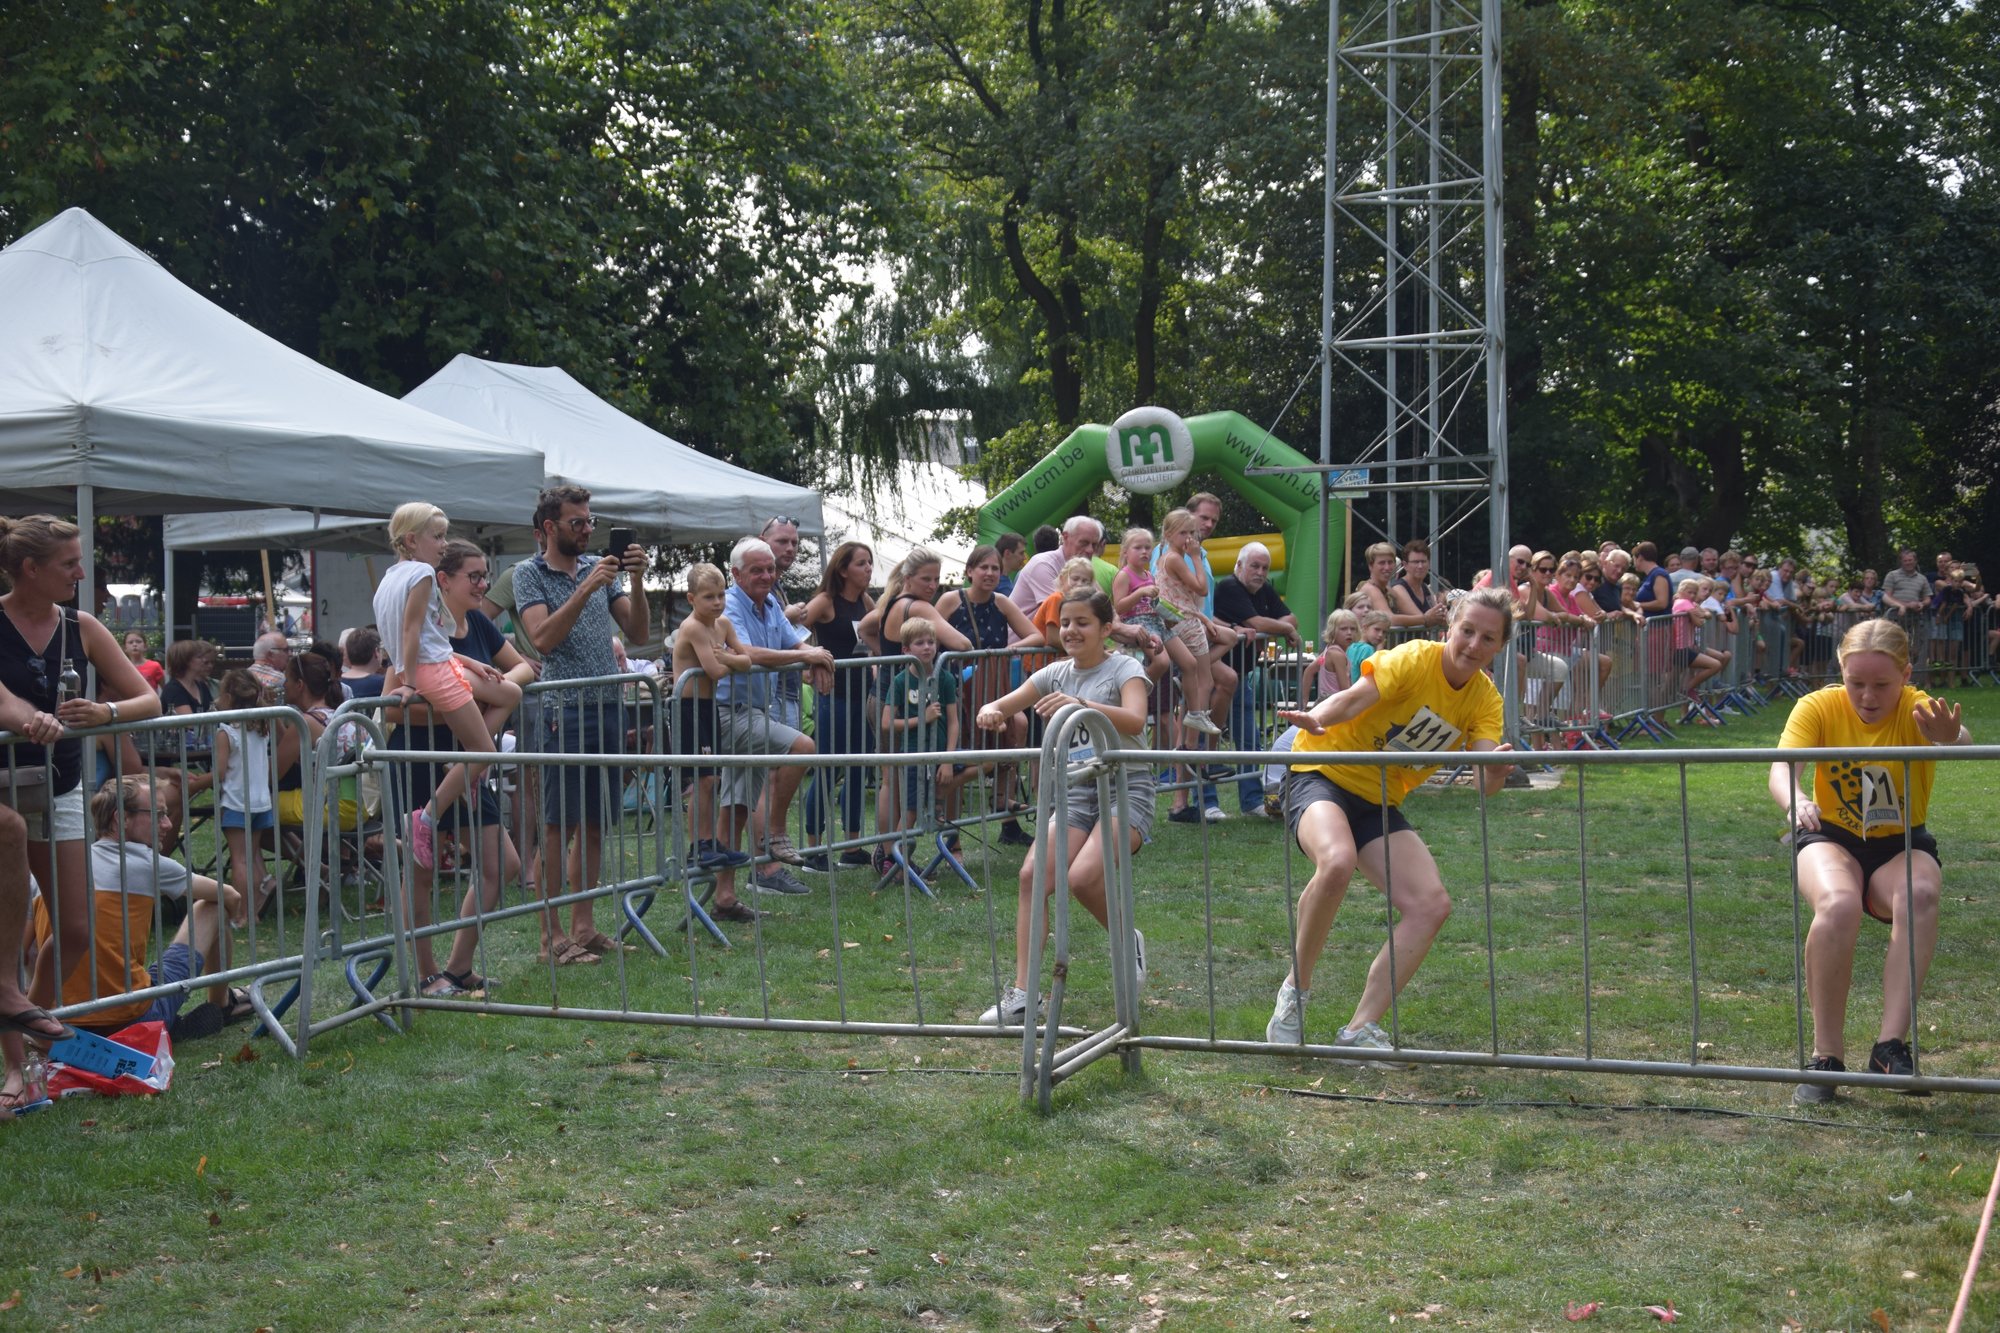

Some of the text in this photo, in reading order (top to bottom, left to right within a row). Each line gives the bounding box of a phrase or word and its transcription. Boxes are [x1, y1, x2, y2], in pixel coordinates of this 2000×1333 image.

[992, 447, 1084, 520] www.cm.be
[321, 599, 328, 616] 2
[1405, 717, 1452, 752] 411
